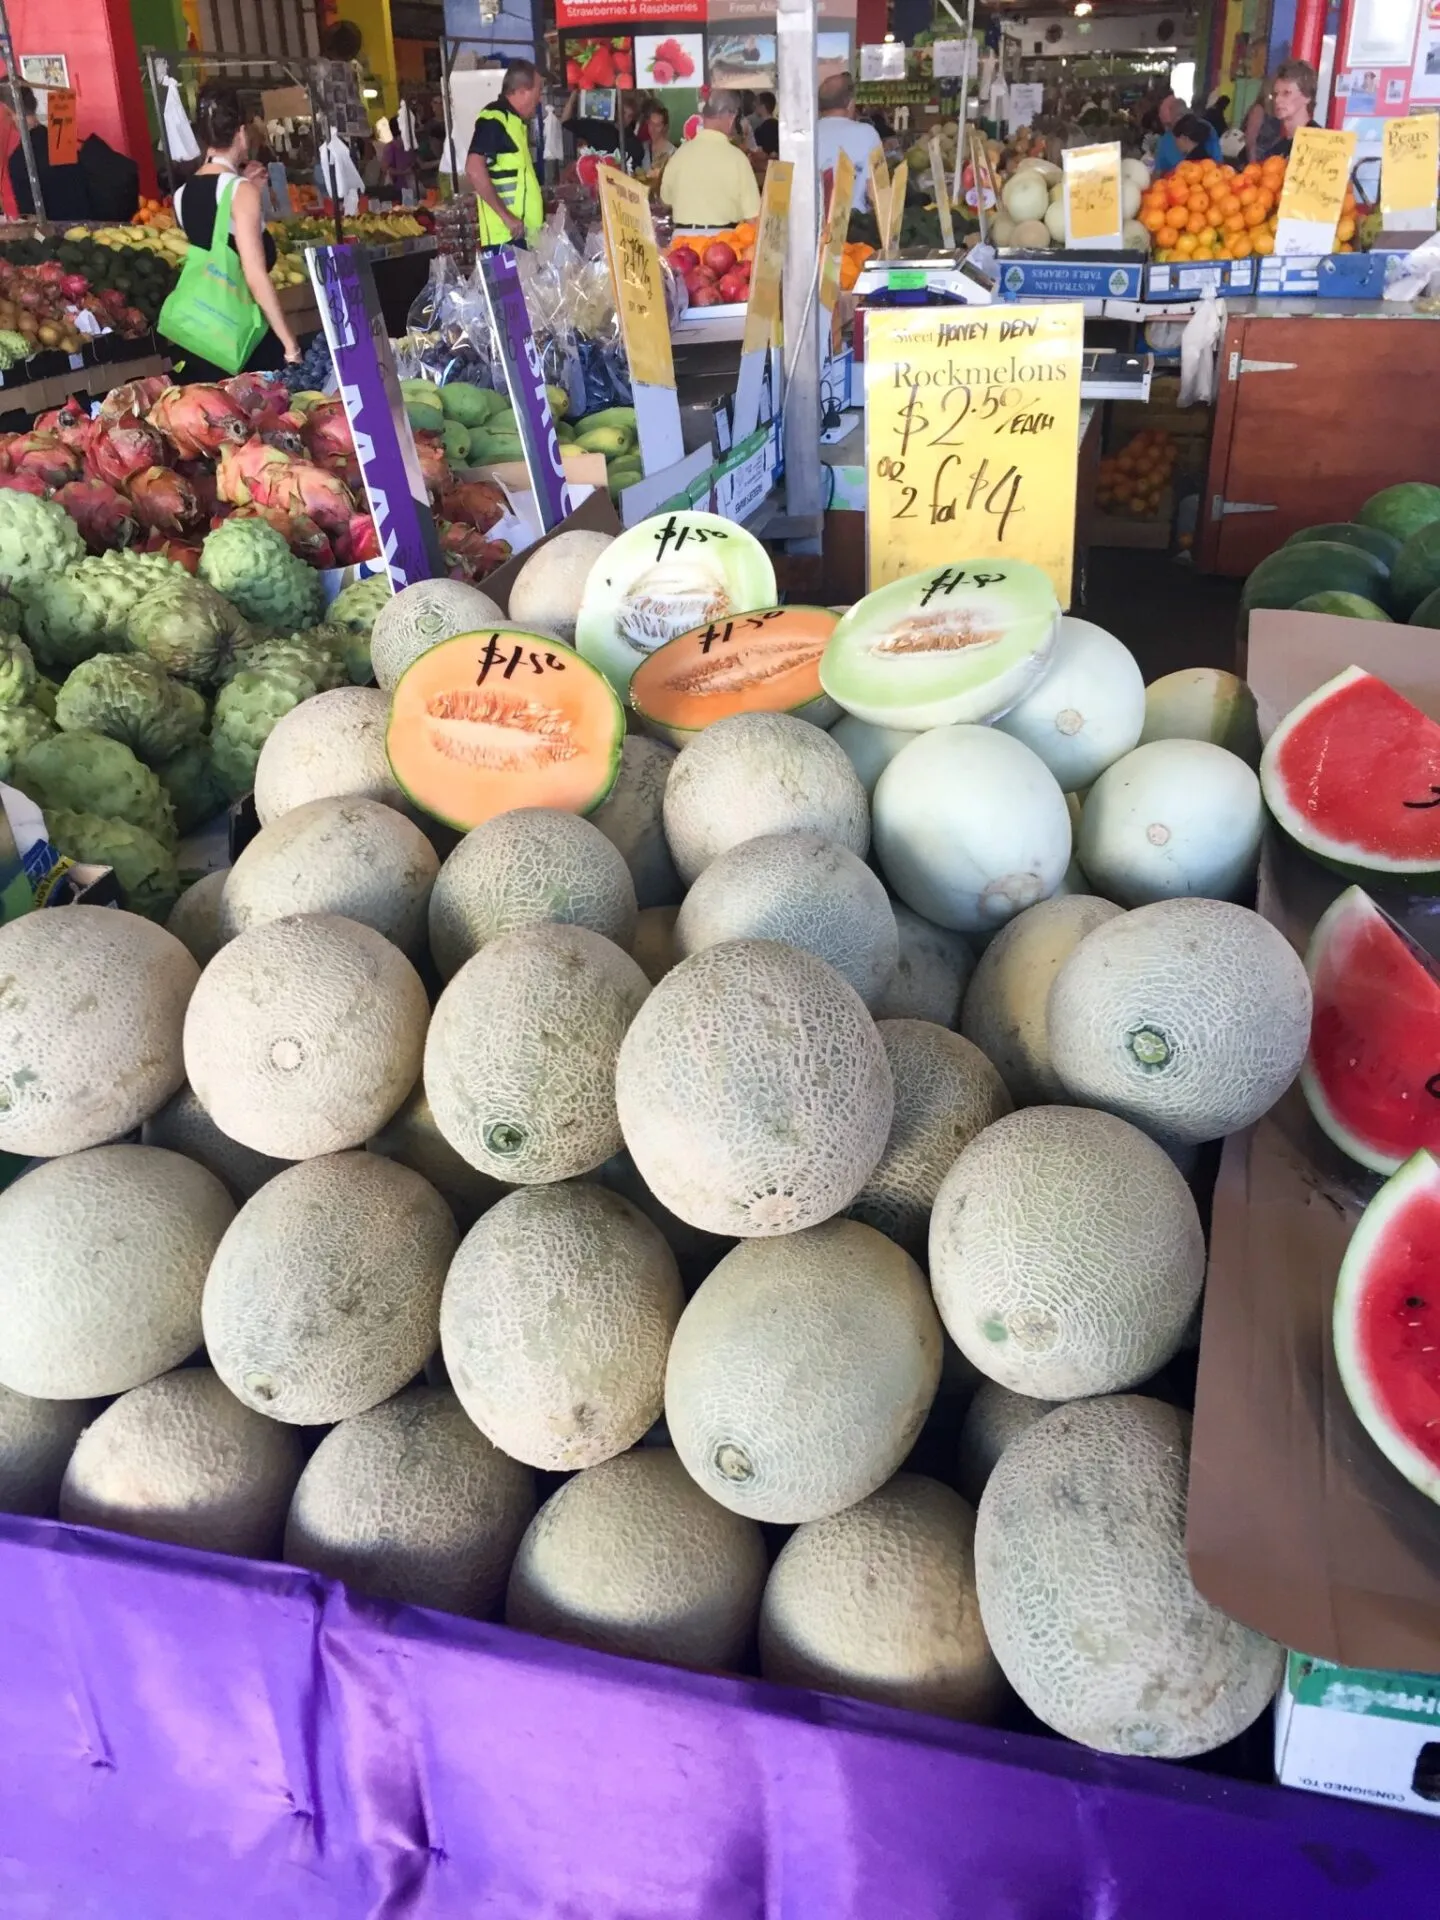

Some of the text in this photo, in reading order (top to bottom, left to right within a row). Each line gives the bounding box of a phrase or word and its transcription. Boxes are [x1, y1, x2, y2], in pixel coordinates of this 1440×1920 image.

[566, 3, 699, 17] Strawberries & Raspberries
[729, 3, 757, 13] From
[1388, 130, 1429, 146] Pears
[1031, 268, 1102, 280] TABLE GRAPES
[1034, 281, 1096, 292] AUSTRALIAN
[937, 321, 988, 347] HONEY
[893, 356, 1067, 388] Rockmelons
[892, 486, 918, 518] 2
[1323, 1781, 1406, 1803] CONSIGNED
